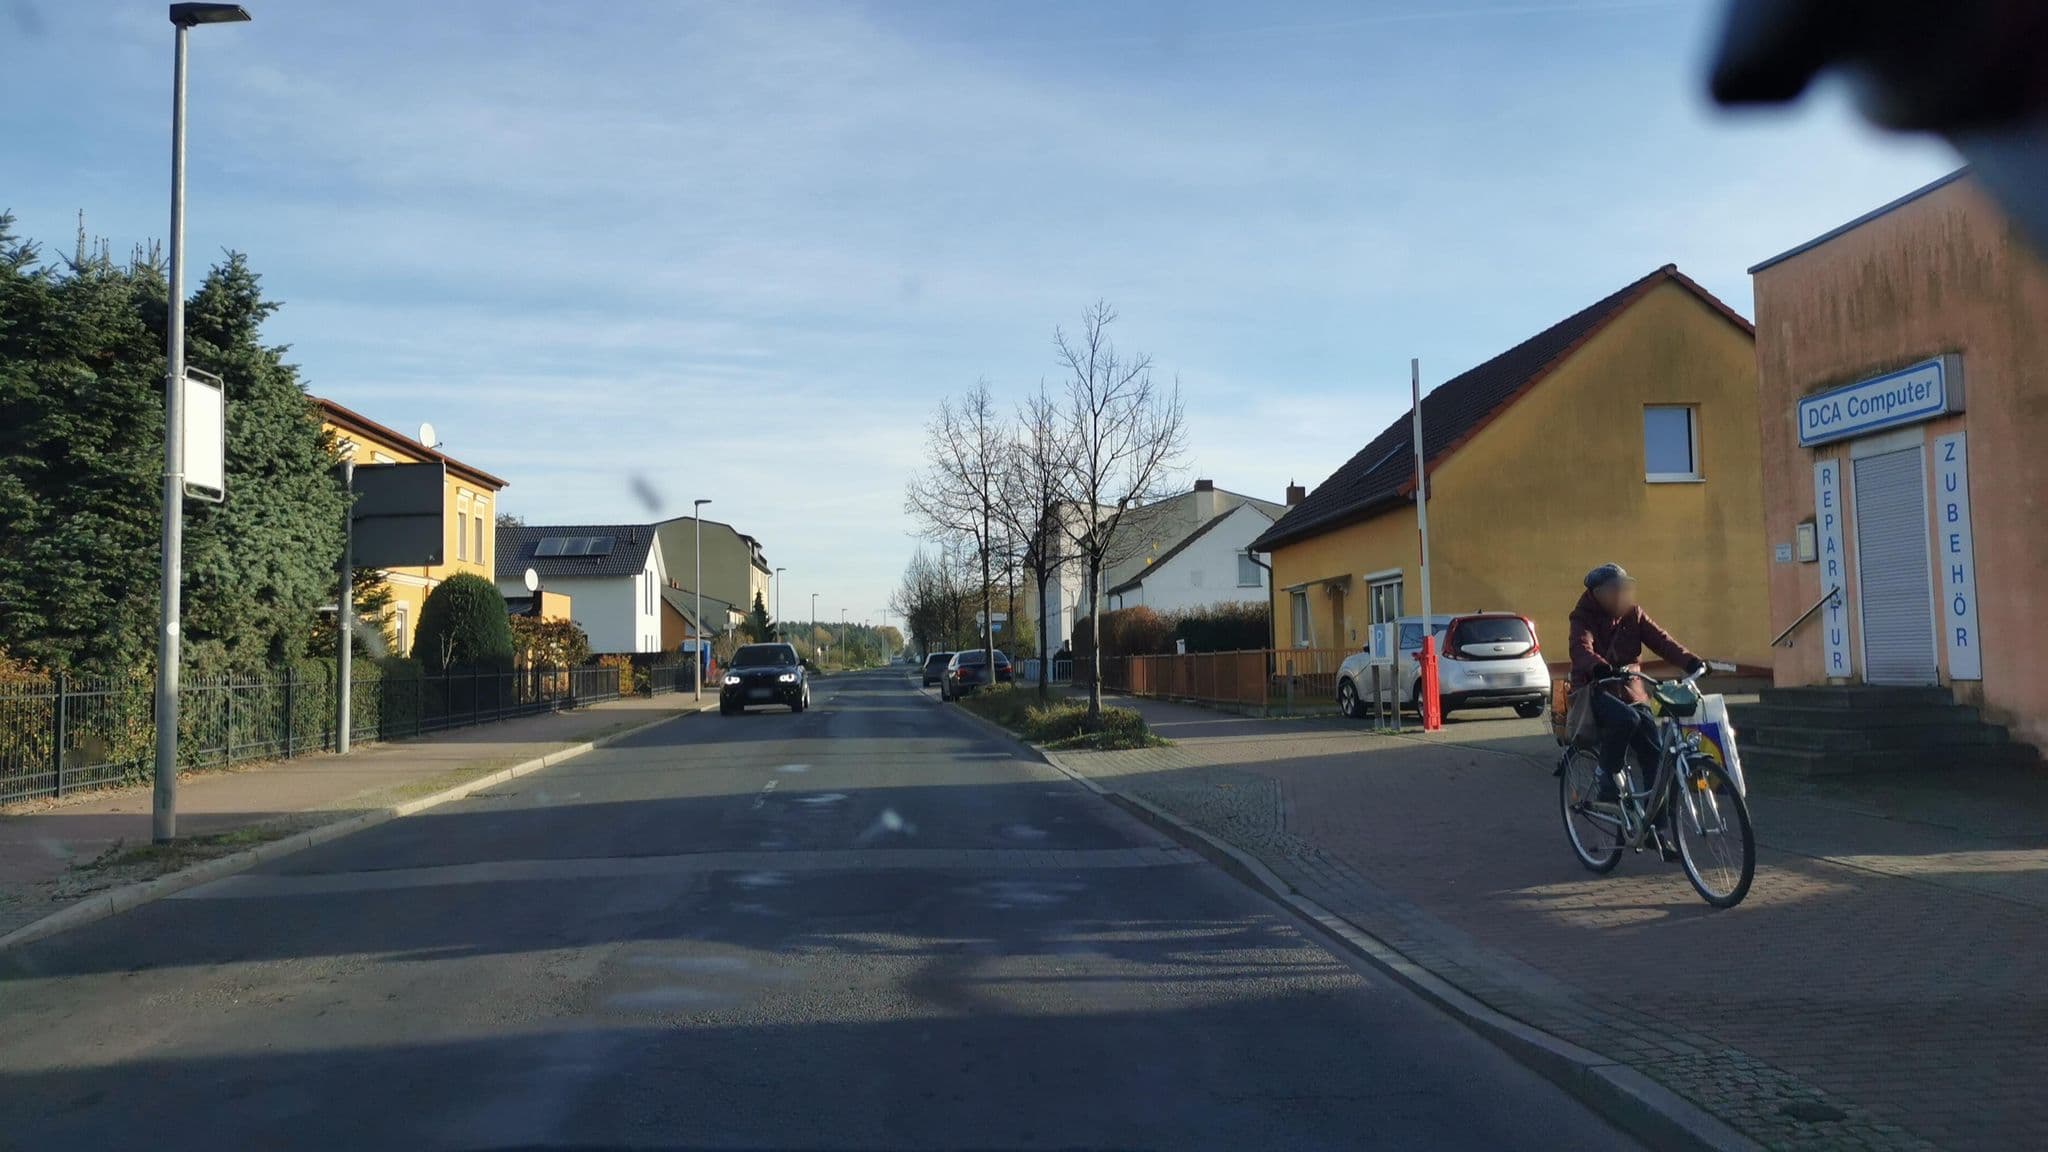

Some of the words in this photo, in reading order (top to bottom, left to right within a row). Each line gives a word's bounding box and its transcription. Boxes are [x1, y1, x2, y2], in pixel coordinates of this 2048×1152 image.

[1809, 402, 1841, 428] DCA
[1847, 380, 1932, 418] Computer
[1943, 442, 1967, 647] ZUBEHÖR
